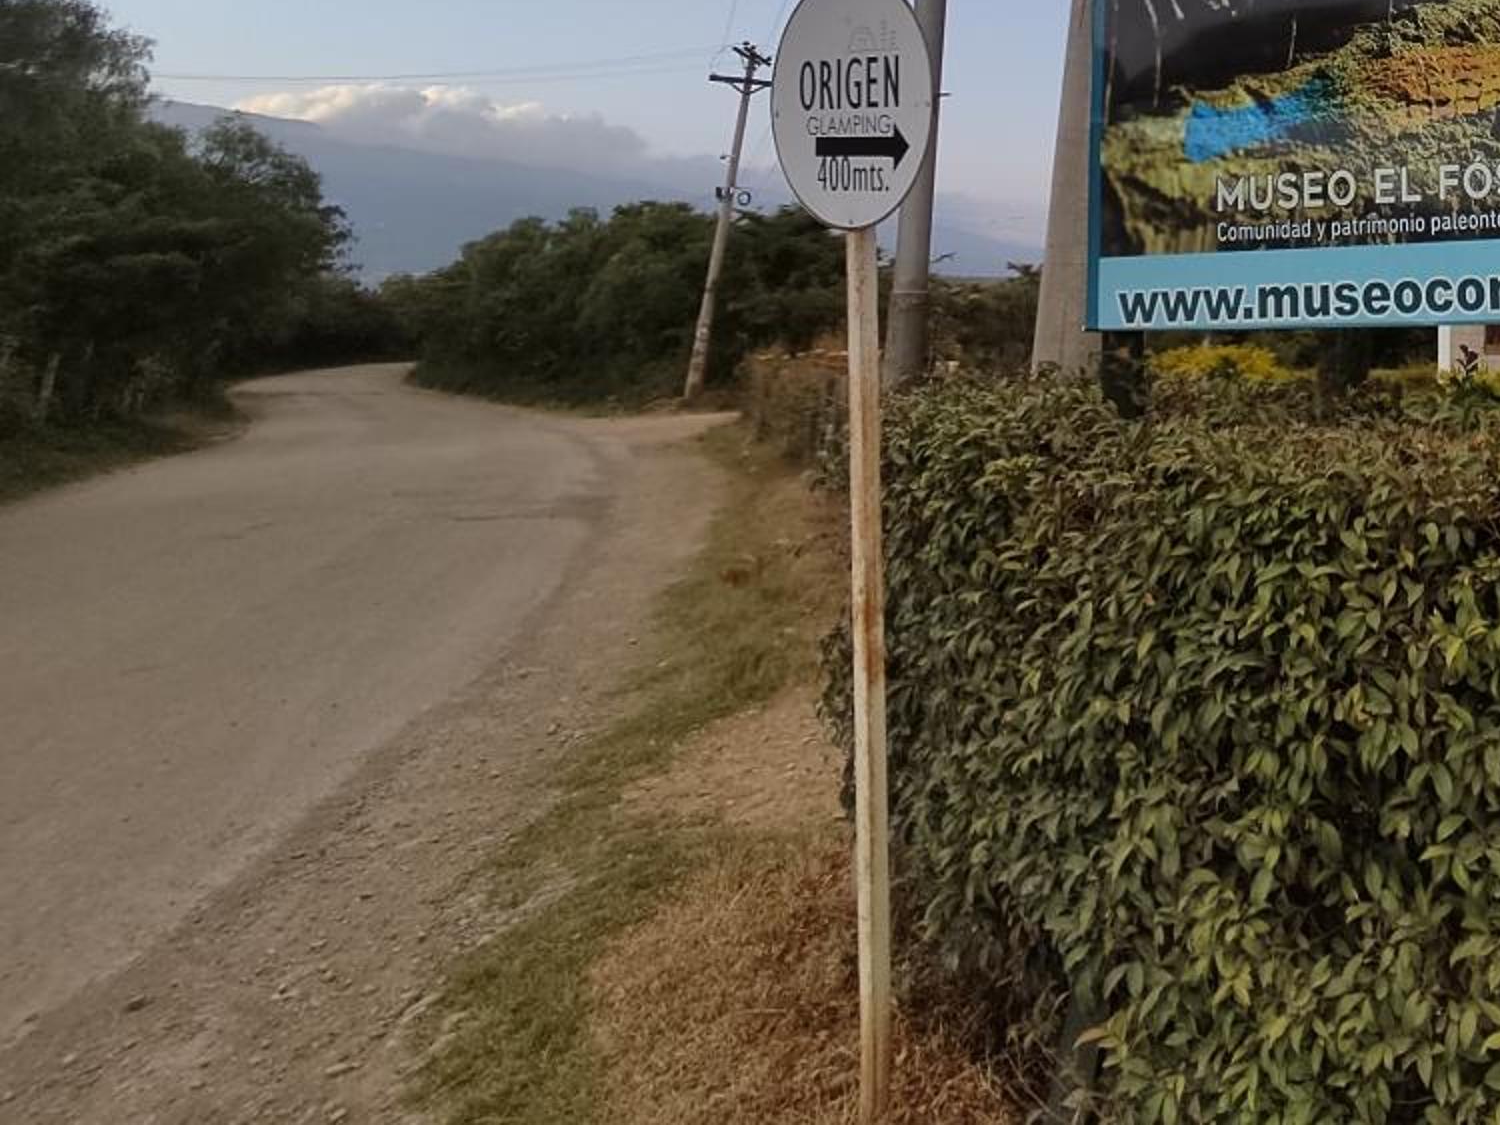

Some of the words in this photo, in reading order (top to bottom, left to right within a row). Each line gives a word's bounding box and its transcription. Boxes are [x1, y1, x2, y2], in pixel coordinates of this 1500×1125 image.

[800, 54, 899, 111] ORIGEN
[807, 114, 892, 136] GLAMPING
[817, 156, 890, 192] 400mts.
[1216, 170, 1357, 212] MUSEO
[1374, 166, 1422, 204] EL
[1216, 218, 1311, 243] Comunidad
[1316, 223, 1325, 241] y
[1331, 214, 1424, 240] patrimonio
